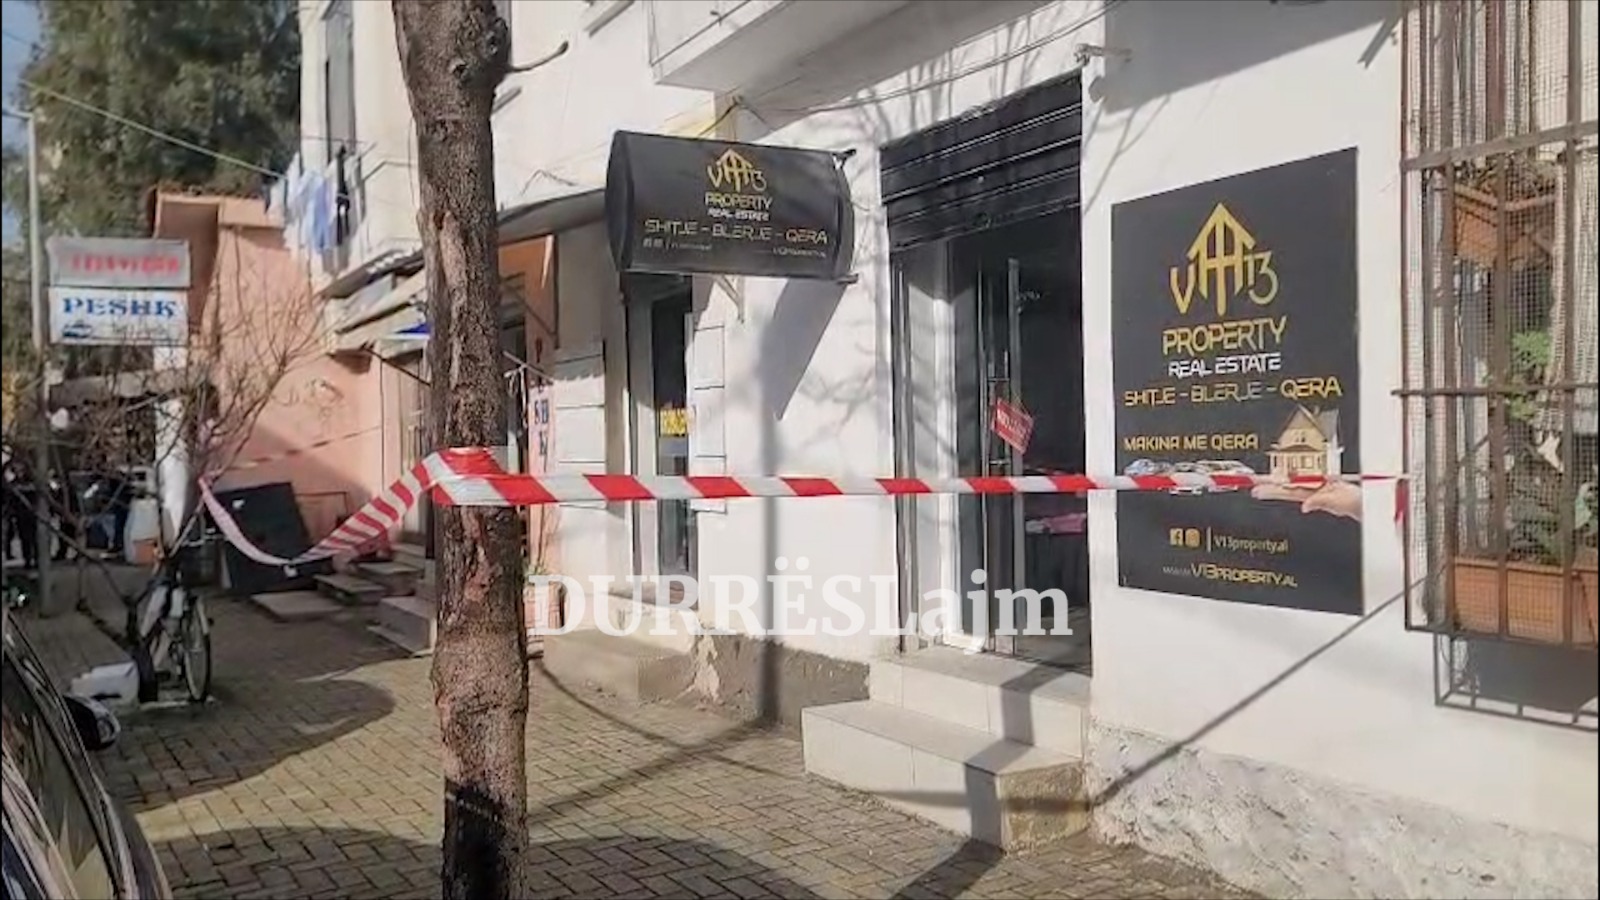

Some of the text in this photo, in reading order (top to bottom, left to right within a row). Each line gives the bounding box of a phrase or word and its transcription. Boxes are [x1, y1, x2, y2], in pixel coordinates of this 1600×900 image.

[705, 192, 773, 209] PROPERTY
[708, 208, 733, 219] REAL
[645, 219, 699, 236] SHITJE
[712, 223, 773, 241] BLERJE
[785, 228, 828, 245] QERA
[63, 297, 176, 318] PESHK
[1162, 316, 1287, 356] PROPERTY
[1168, 352, 1282, 379] REAL ESTATE
[1124, 386, 1176, 408] SHITJE
[1191, 382, 1262, 404] BLERJE
[1280, 376, 1343, 399] QERA
[1123, 433, 1259, 452] MAKINA ME QERA
